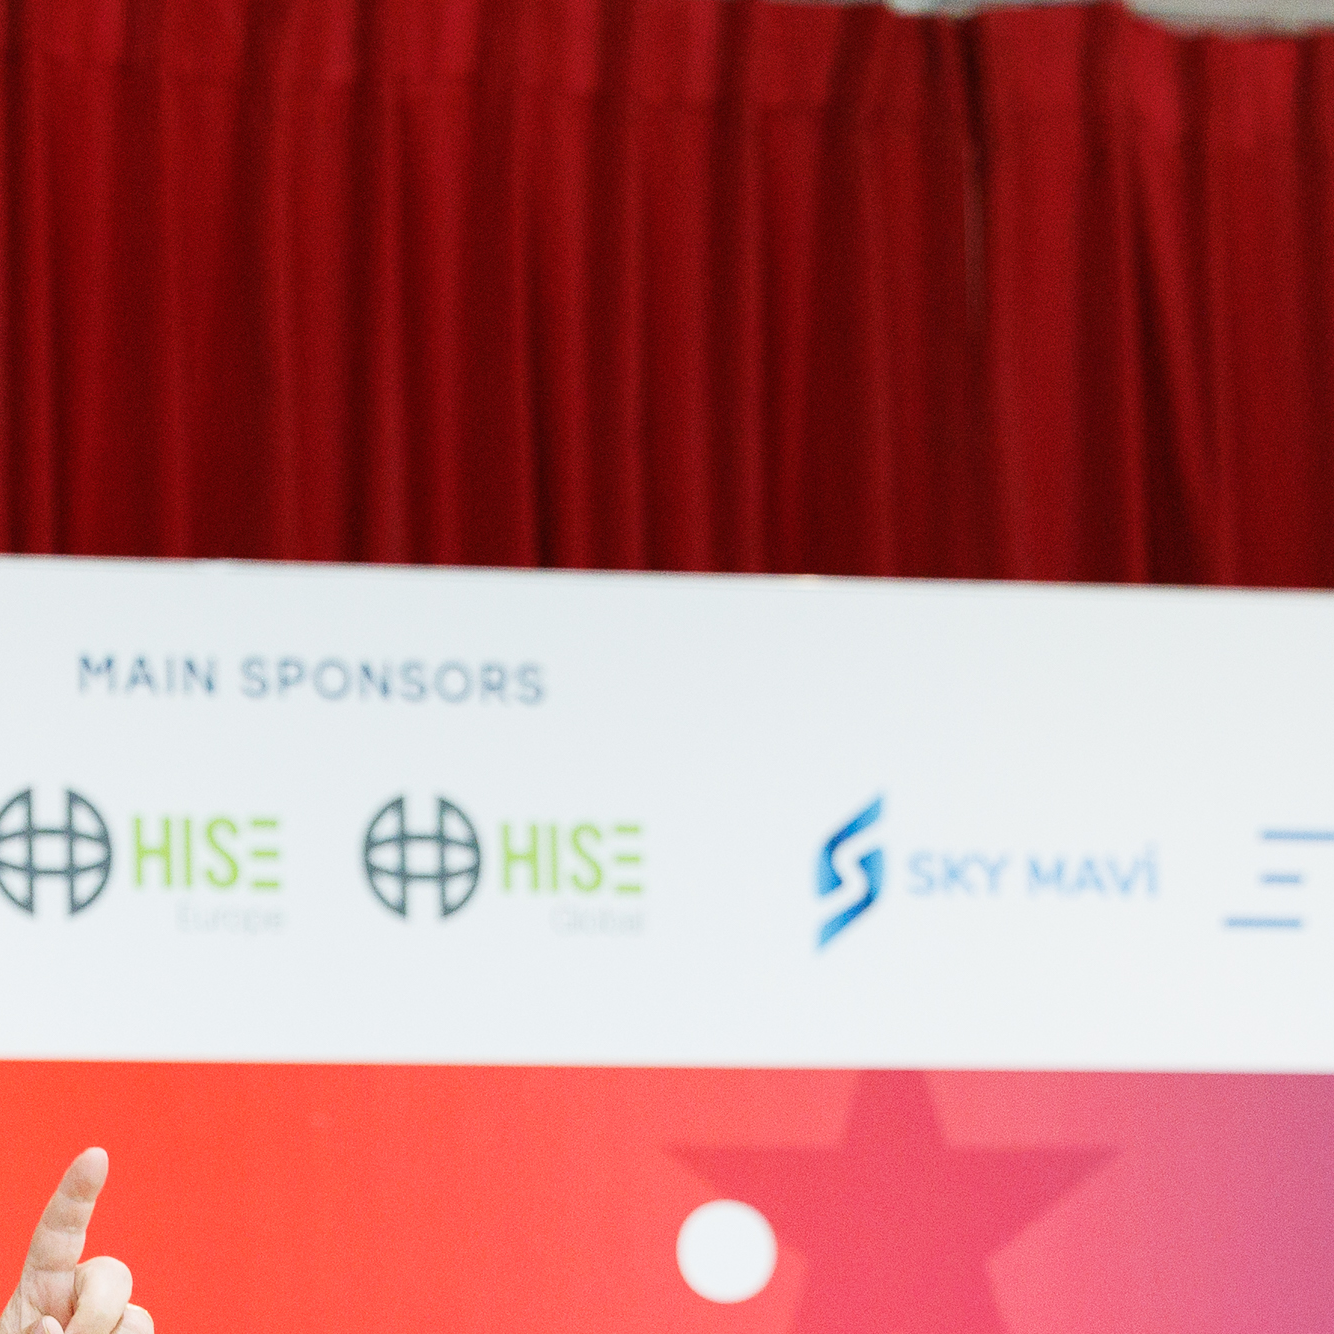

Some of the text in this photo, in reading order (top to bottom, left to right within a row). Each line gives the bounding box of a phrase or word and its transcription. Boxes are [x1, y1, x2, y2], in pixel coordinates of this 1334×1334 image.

[78, 653, 546, 707] MAIN SPONSORS
[133, 815, 282, 891] HISE
[501, 821, 643, 895] HISE
[907, 855, 1011, 898] SKY
[175, 904, 286, 935] Europe
[551, 905, 644, 936] Global
